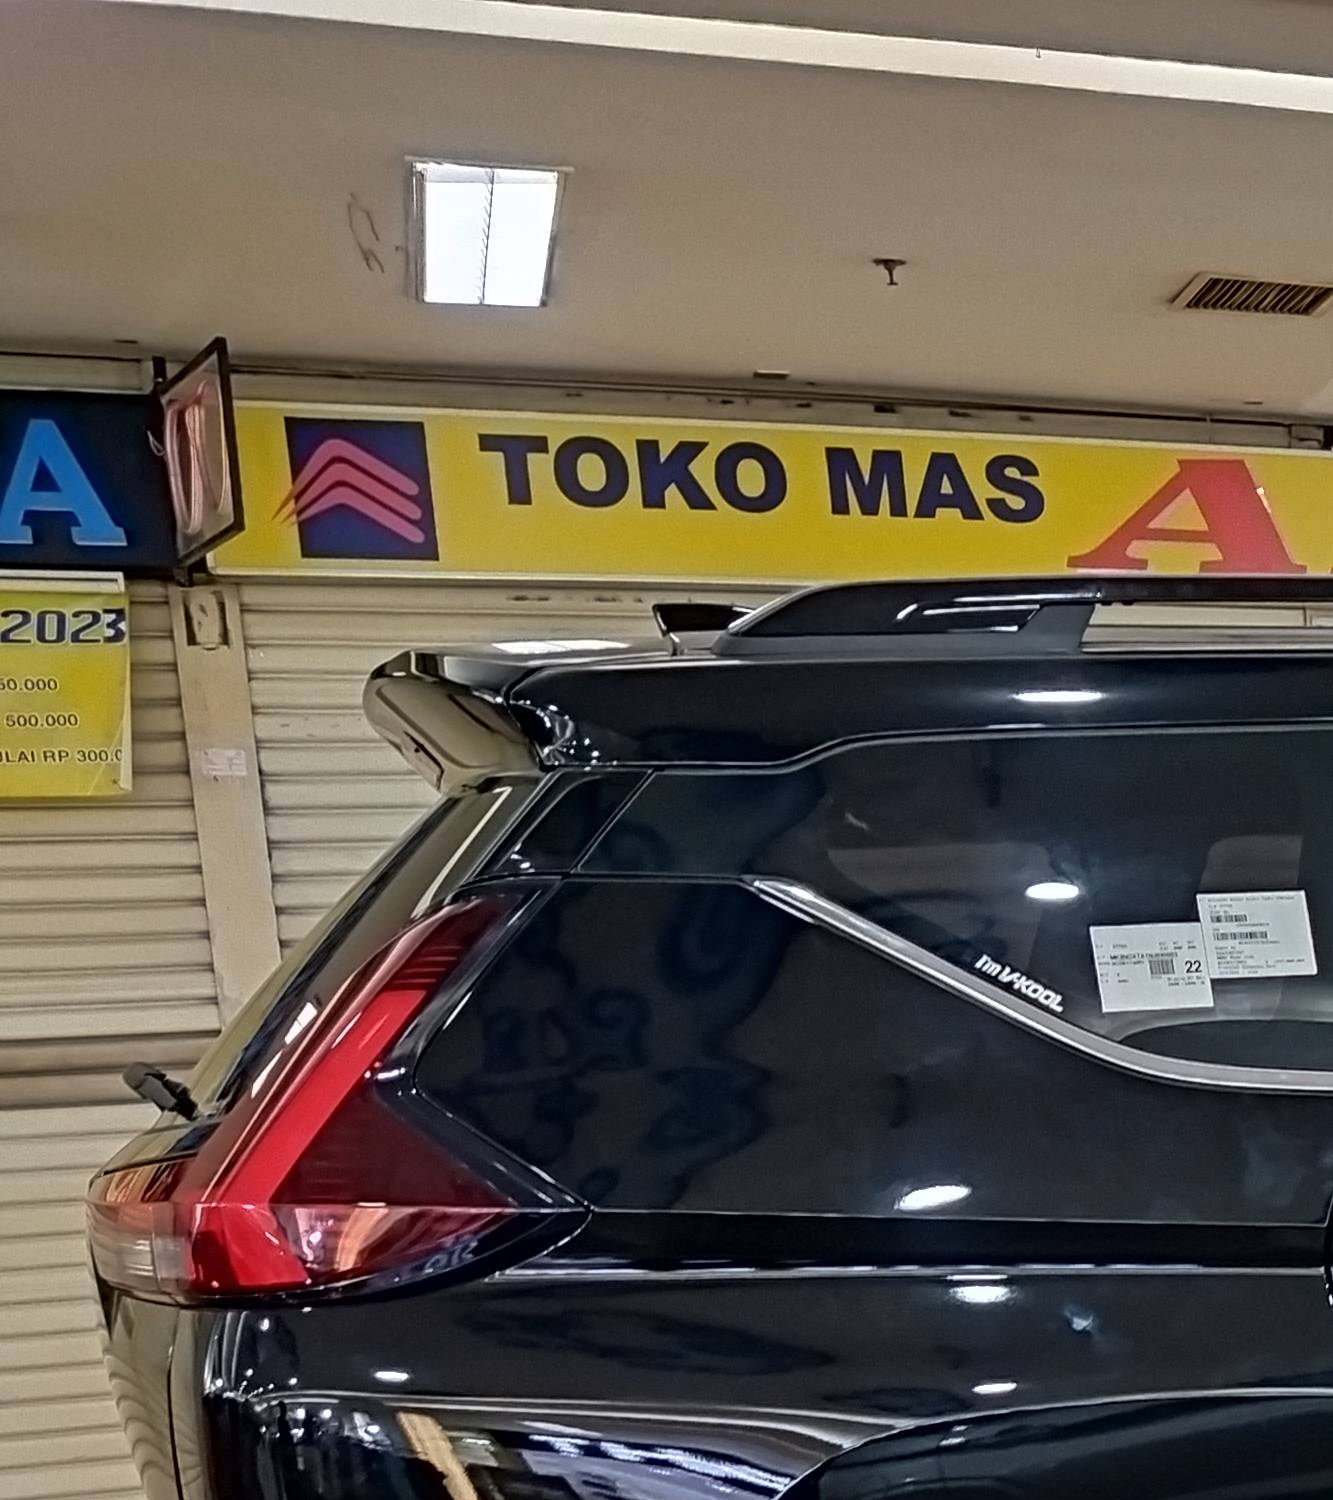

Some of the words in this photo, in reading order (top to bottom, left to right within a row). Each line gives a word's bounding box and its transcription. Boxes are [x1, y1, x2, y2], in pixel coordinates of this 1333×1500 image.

[479, 433, 788, 514] TOKO
[824, 446, 1045, 523] MAS
[0, 607, 126, 643] 2023
[6, 713, 79, 728] 500.000
[0, 749, 36, 763] LAI
[43, 749, 69, 763] RP
[1185, 959, 1202, 974] 22
